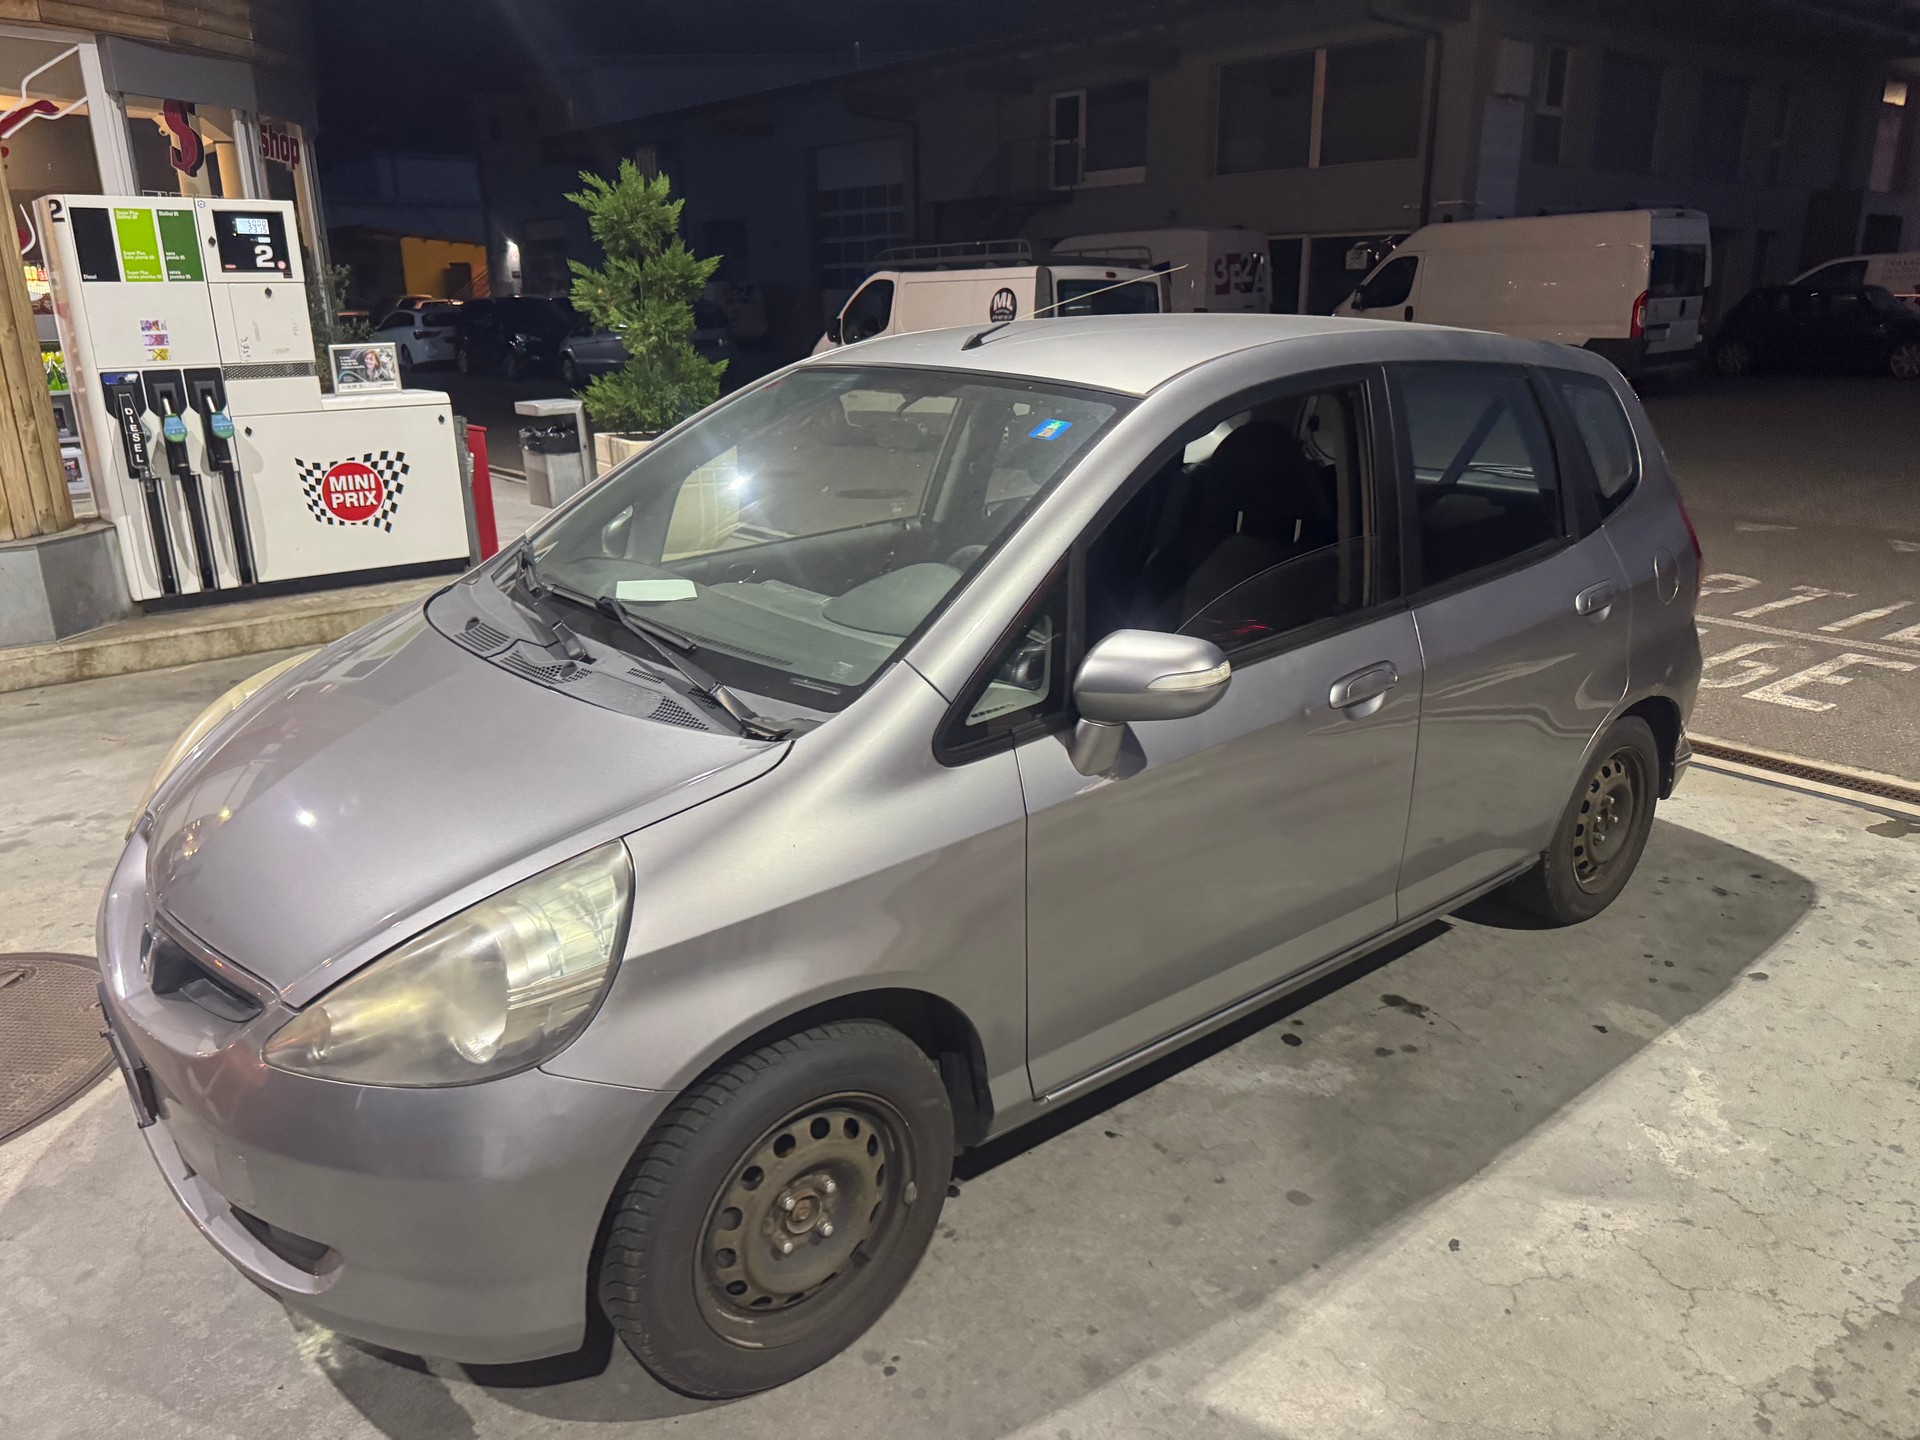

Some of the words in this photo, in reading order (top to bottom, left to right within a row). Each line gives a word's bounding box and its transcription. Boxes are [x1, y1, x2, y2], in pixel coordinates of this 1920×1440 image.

[48, 199, 66, 223] 2
[254, 245, 275, 268] 2
[124, 407, 144, 463] DIESEL
[329, 473, 376, 492] MINI
[330, 490, 378, 509] PRIX
